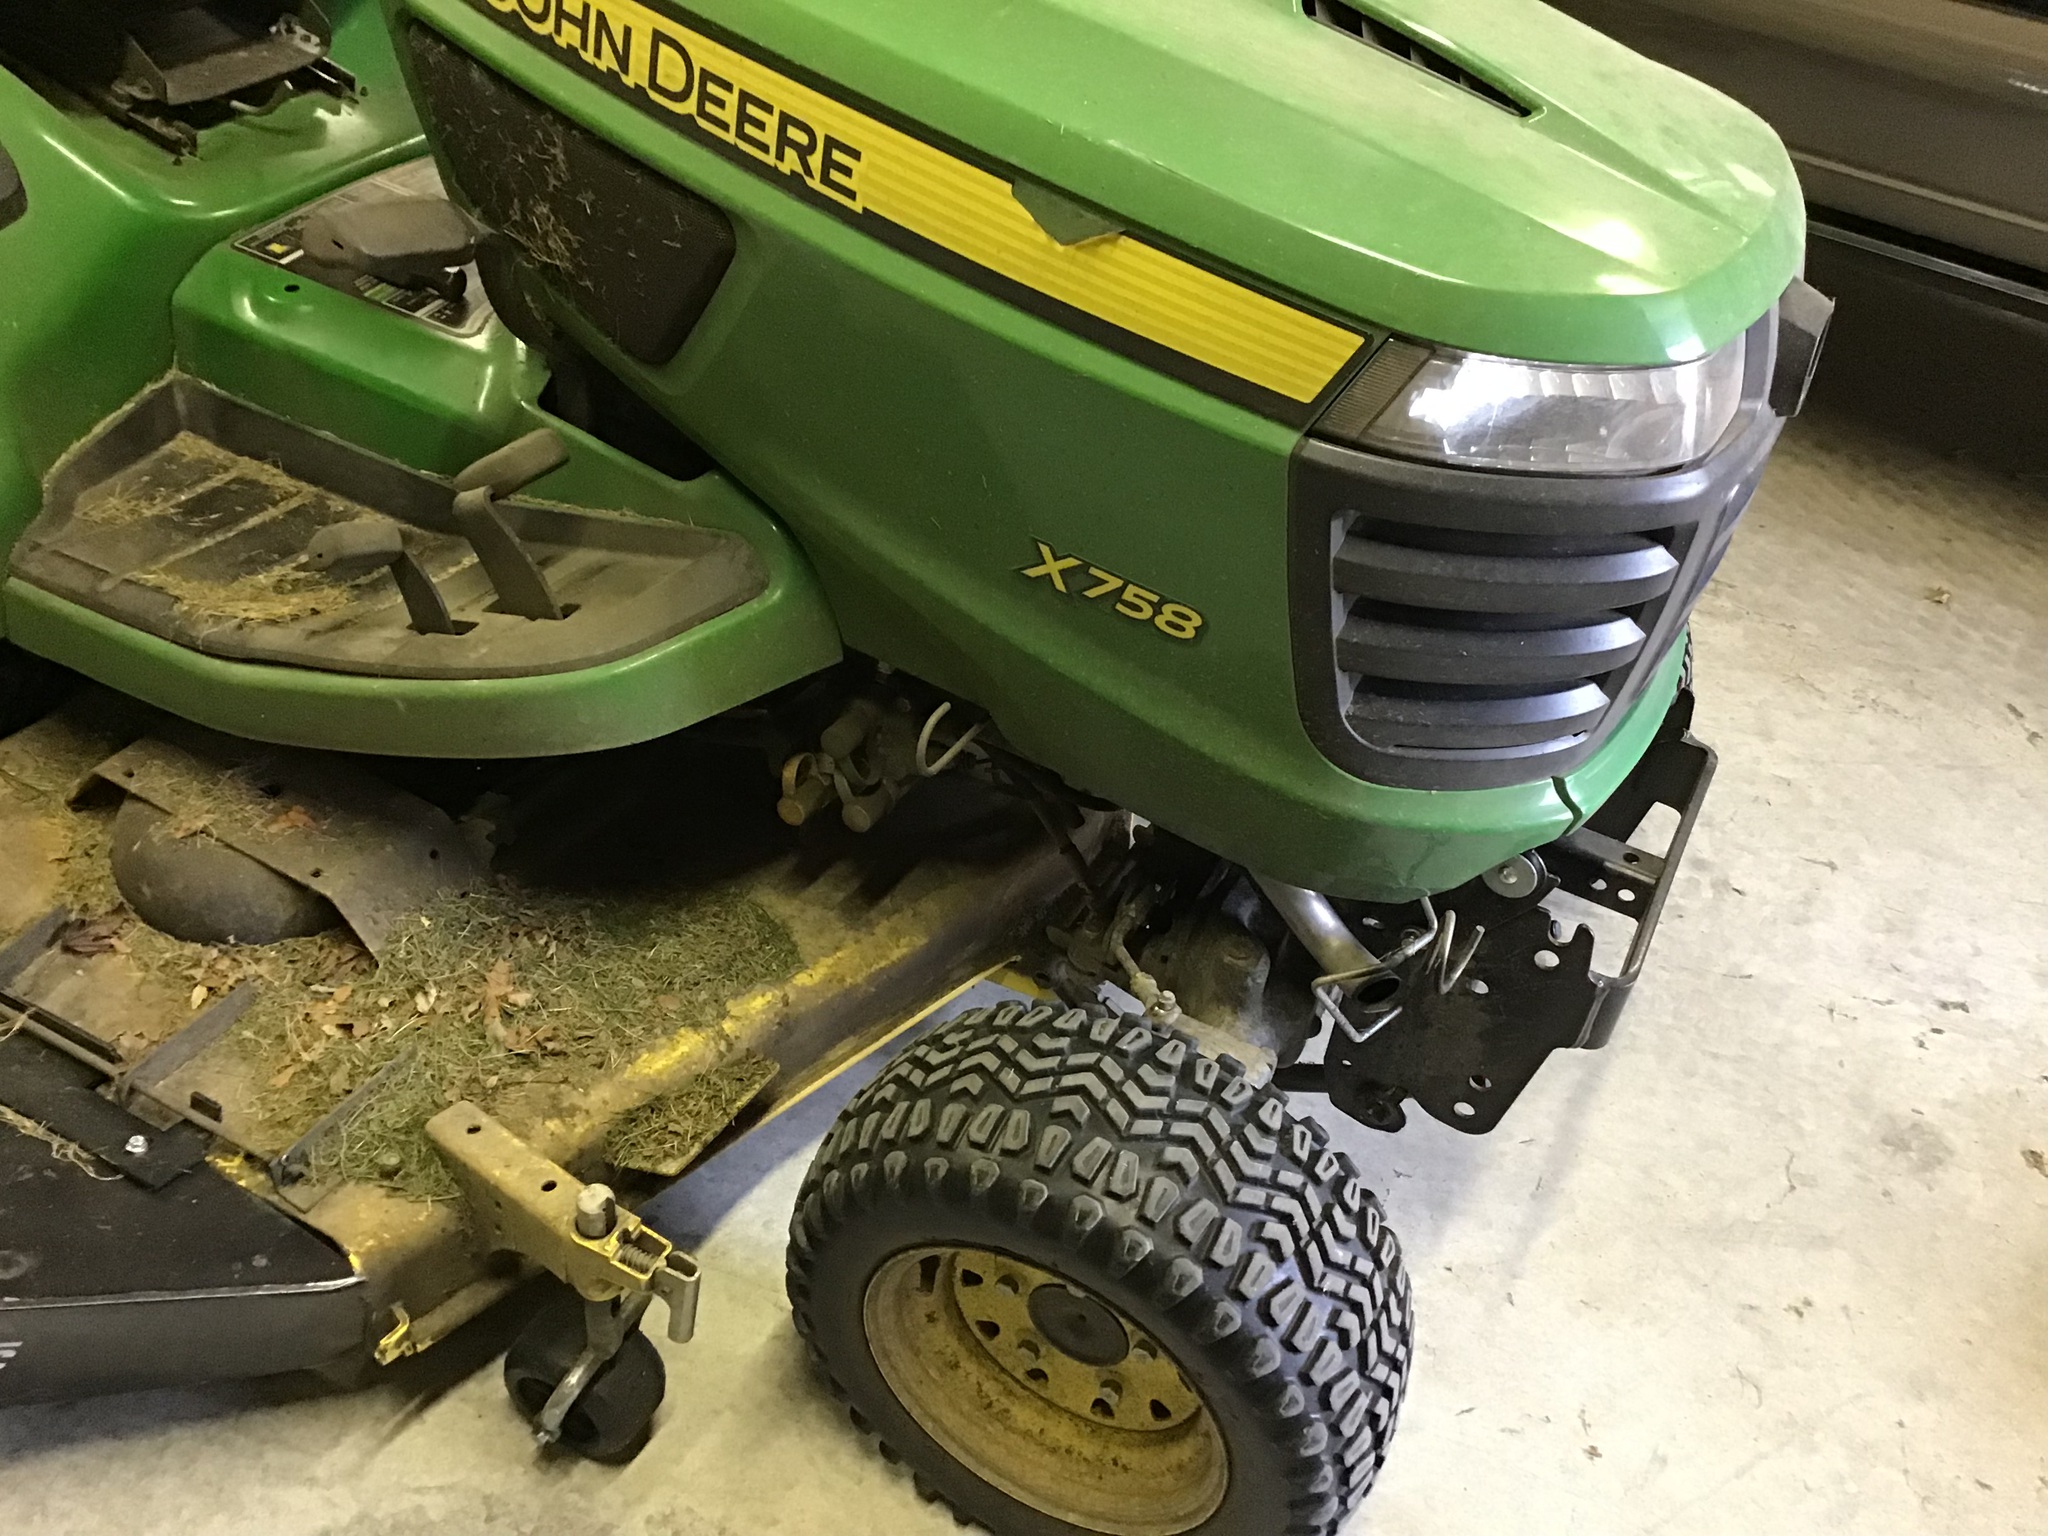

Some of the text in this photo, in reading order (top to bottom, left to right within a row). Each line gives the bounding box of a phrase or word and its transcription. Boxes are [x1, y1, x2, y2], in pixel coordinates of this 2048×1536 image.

[498, 0, 863, 204] OHN DEERE
[1019, 540, 1204, 641] X758
